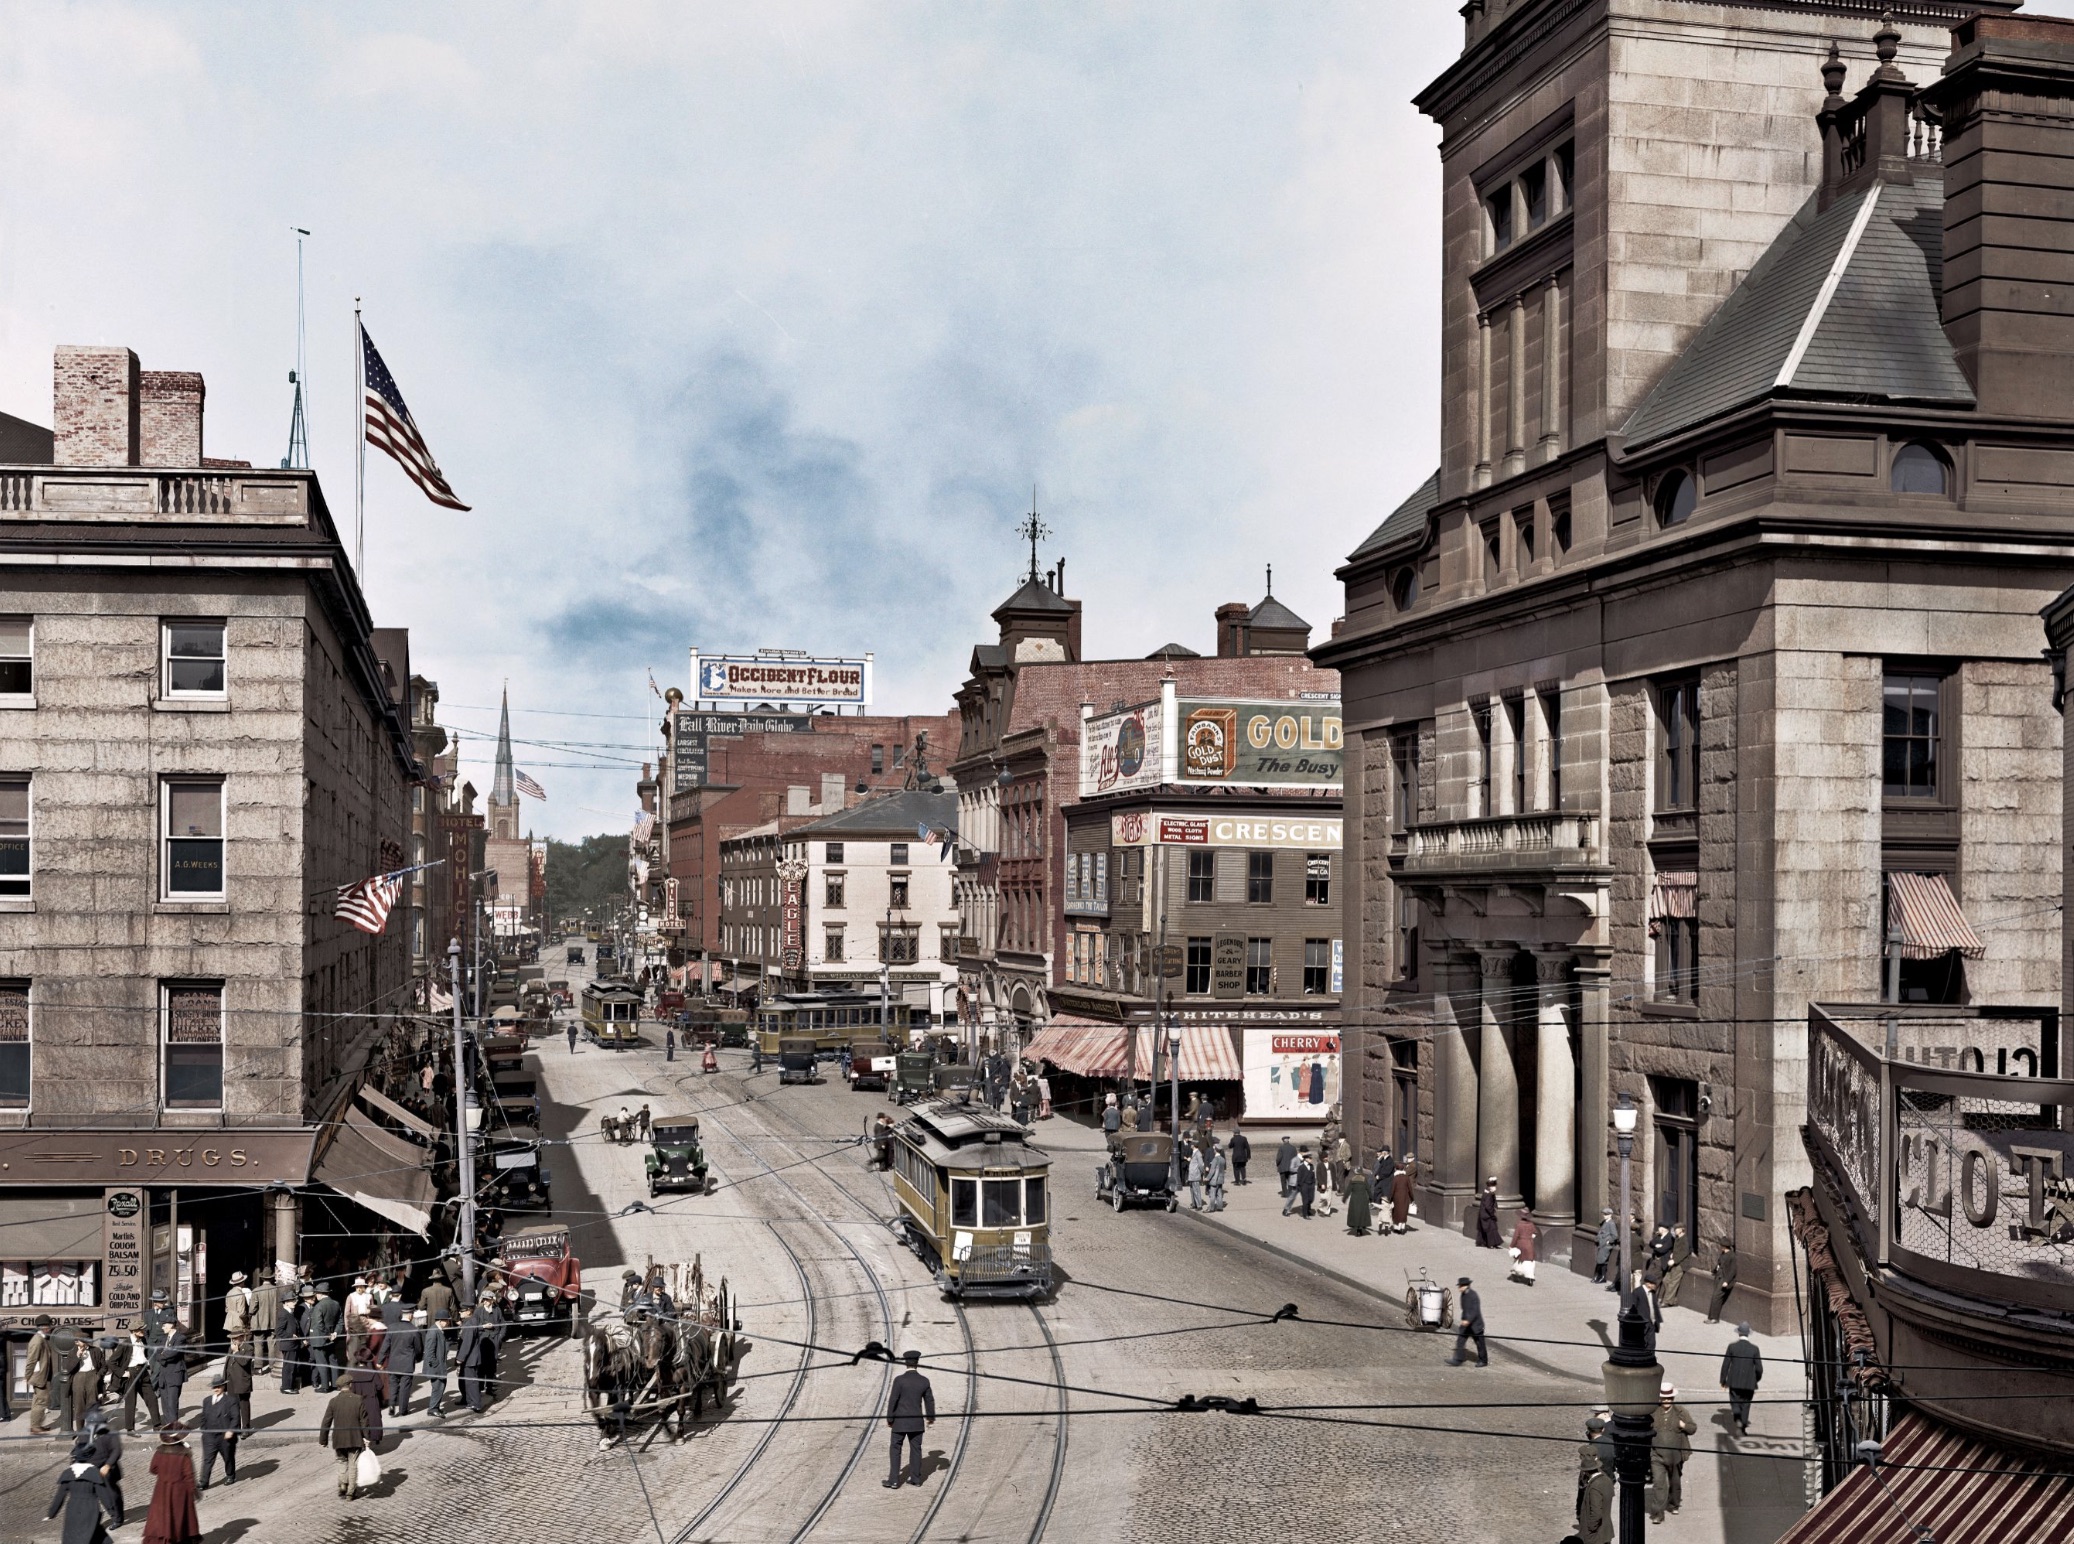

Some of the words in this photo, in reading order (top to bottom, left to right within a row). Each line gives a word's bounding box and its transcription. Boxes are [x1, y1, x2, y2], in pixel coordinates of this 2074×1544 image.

[728, 665, 805, 684] OCCIDENT
[807, 667, 861, 685] FLOUR
[730, 686, 757, 694] Makes
[802, 687, 830, 696] Better
[679, 716, 703, 732] Fall
[706, 716, 738, 733] River
[1247, 715, 1343, 750] GOLD
[1188, 746, 1215, 759] GOLD
[1200, 751, 1224, 766] DUST
[1256, 758, 1291, 774] The
[1295, 759, 1339, 779] Busy
[441, 817, 482, 828] HOTEL
[1215, 822, 1342, 842] CRESCEN
[495, 910, 519, 920] WEBB
[787, 880, 798, 946] EAGLE
[659, 920, 684, 928] HOTEL
[1217, 957, 1242, 965] GEARY
[1216, 970, 1243, 978] BARBER
[1218, 981, 1241, 990] SHOP
[1160, 1011, 1322, 1020] WHITEHEAD'S
[1273, 1037, 1321, 1048] CHERRY
[112, 1232, 135, 1240] Martin's
[109, 1241, 136, 1250] COUGH
[109, 1251, 140, 1259] BALSAM
[108, 1292, 126, 1301] COLD
[126, 1292, 141, 1301] AND
